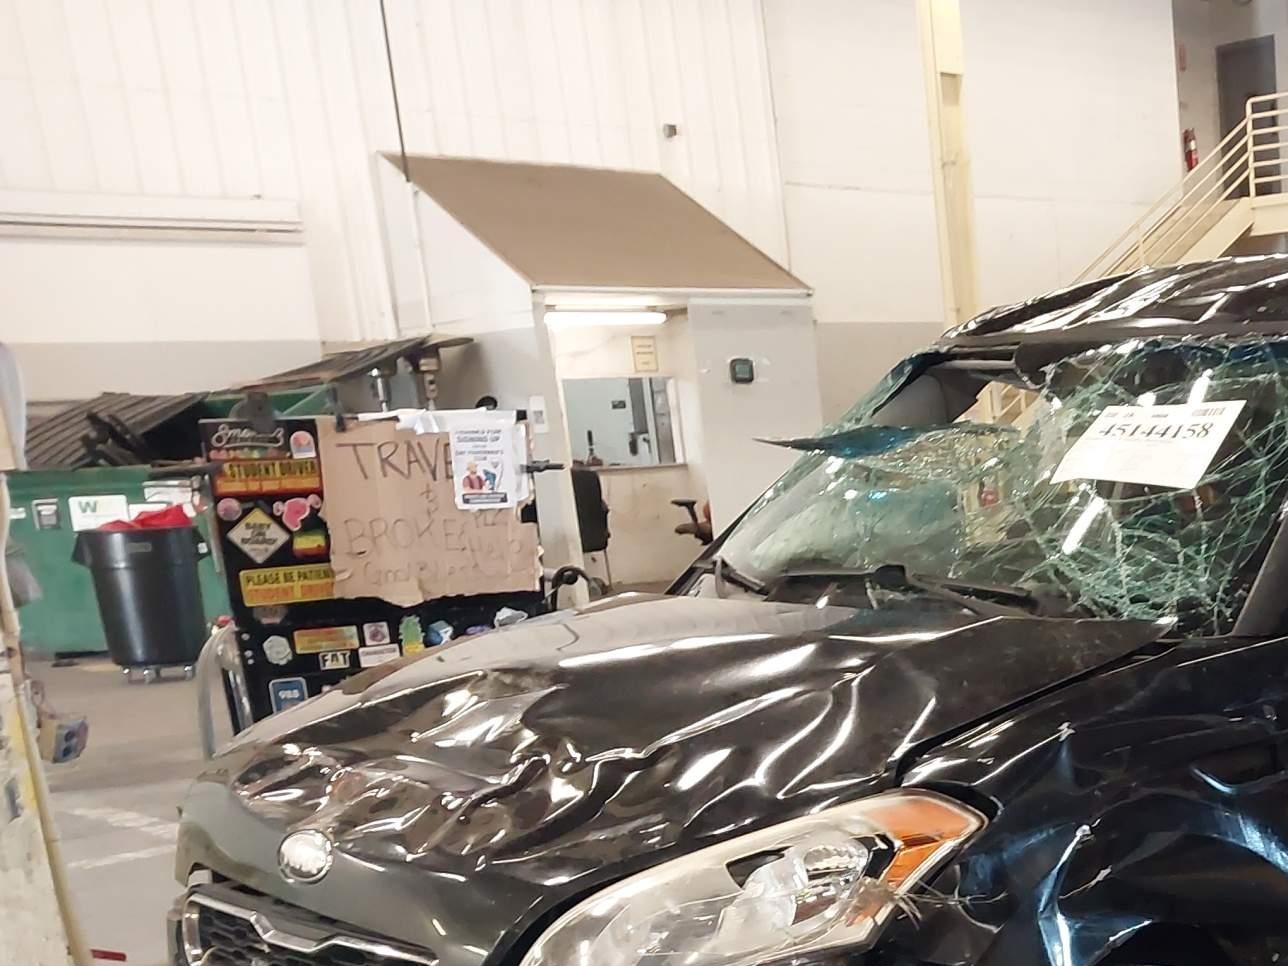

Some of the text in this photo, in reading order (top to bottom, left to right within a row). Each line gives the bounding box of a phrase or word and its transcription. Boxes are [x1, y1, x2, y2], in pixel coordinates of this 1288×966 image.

[1098, 422, 1214, 439] 45144158
[246, 572, 281, 586] PLEASE
[320, 652, 349, 668] FAT
